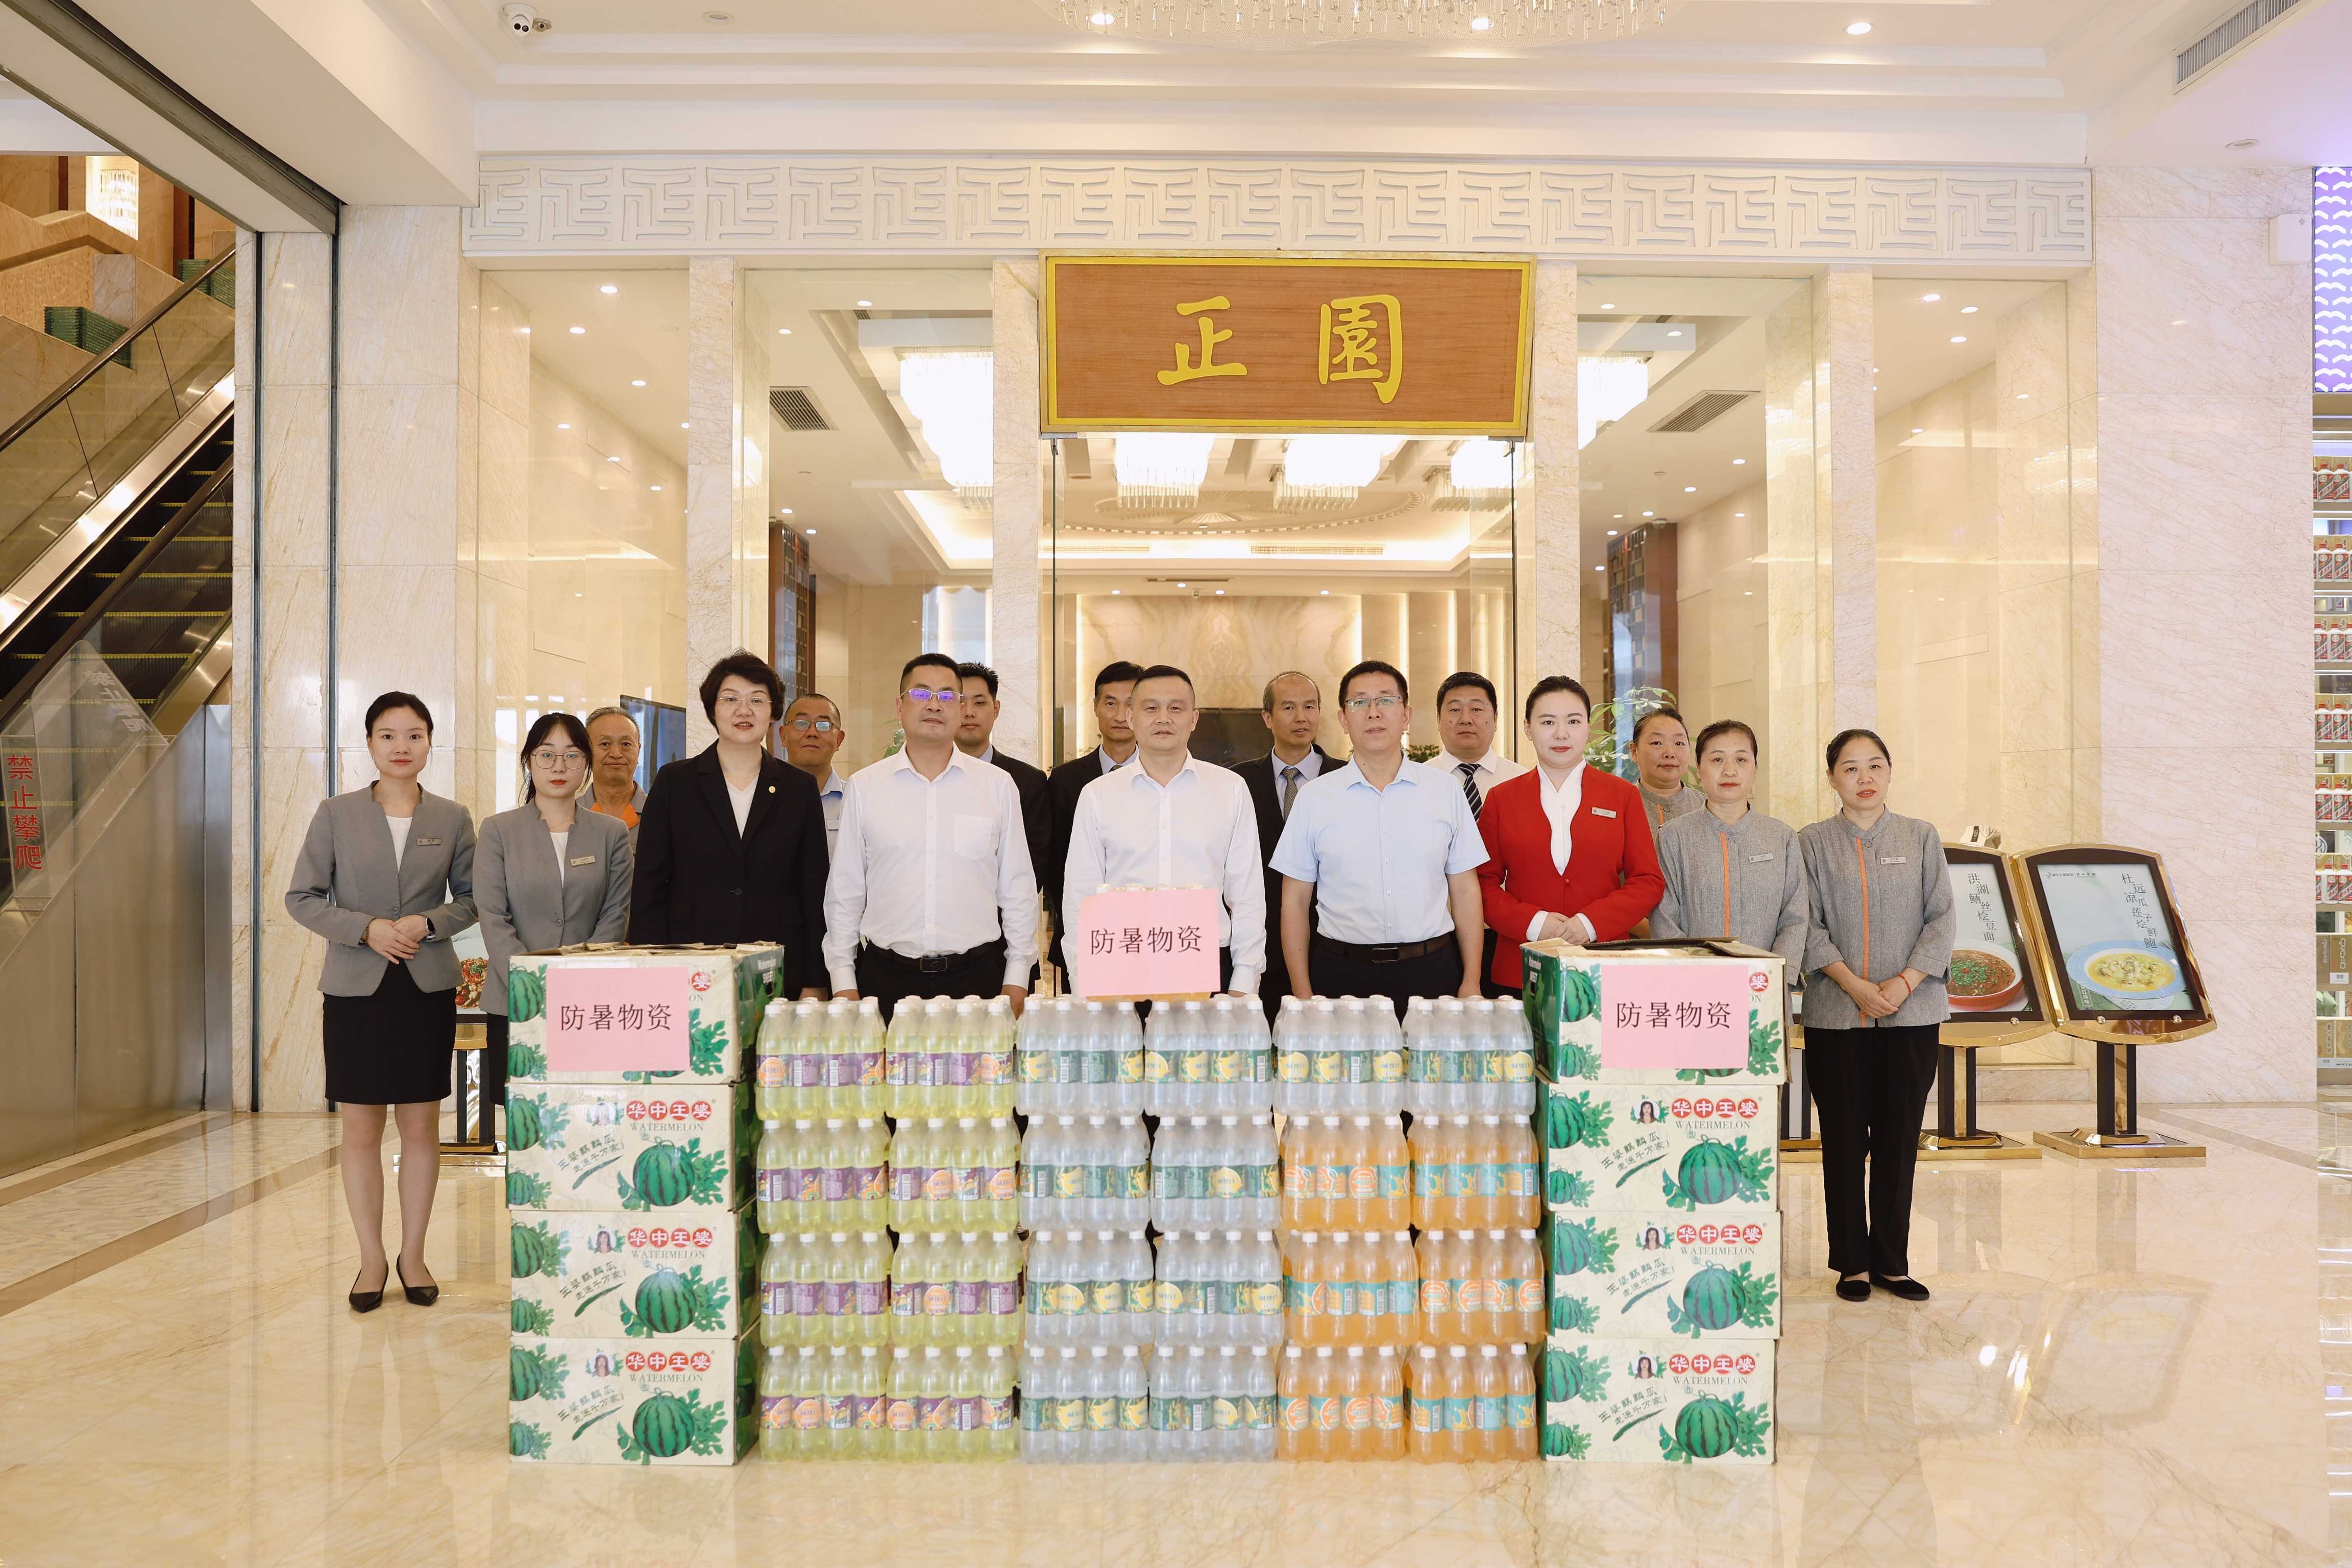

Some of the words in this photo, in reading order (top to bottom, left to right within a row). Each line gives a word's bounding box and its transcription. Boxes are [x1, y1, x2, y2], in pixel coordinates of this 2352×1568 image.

[1156, 294, 1402, 404] 正園
[7, 754, 43, 870] 禁止攀爬
[1091, 925, 1202, 955] 防暑物资
[560, 1003, 672, 1031] 防暑物资
[1616, 1001, 1732, 1030] 防暑物资
[627, 1100, 712, 1120] 华中王婆
[1672, 1098, 1759, 1118] 华中王婆
[630, 1123, 704, 1132] WATERMELON
[1675, 1120, 1750, 1129] WATERMELON
[627, 1228, 713, 1247] 华中王婆
[1677, 1224, 1763, 1244] 华中王婆
[631, 1250, 705, 1258] WATERMELON
[1680, 1246, 1755, 1255] WATERMELON
[626, 1352, 710, 1371] 华中王婆
[1670, 1354, 1756, 1374] 华中王婆
[630, 1374, 703, 1382] WATERMELON
[1673, 1376, 1748, 1385] WATERMELON
